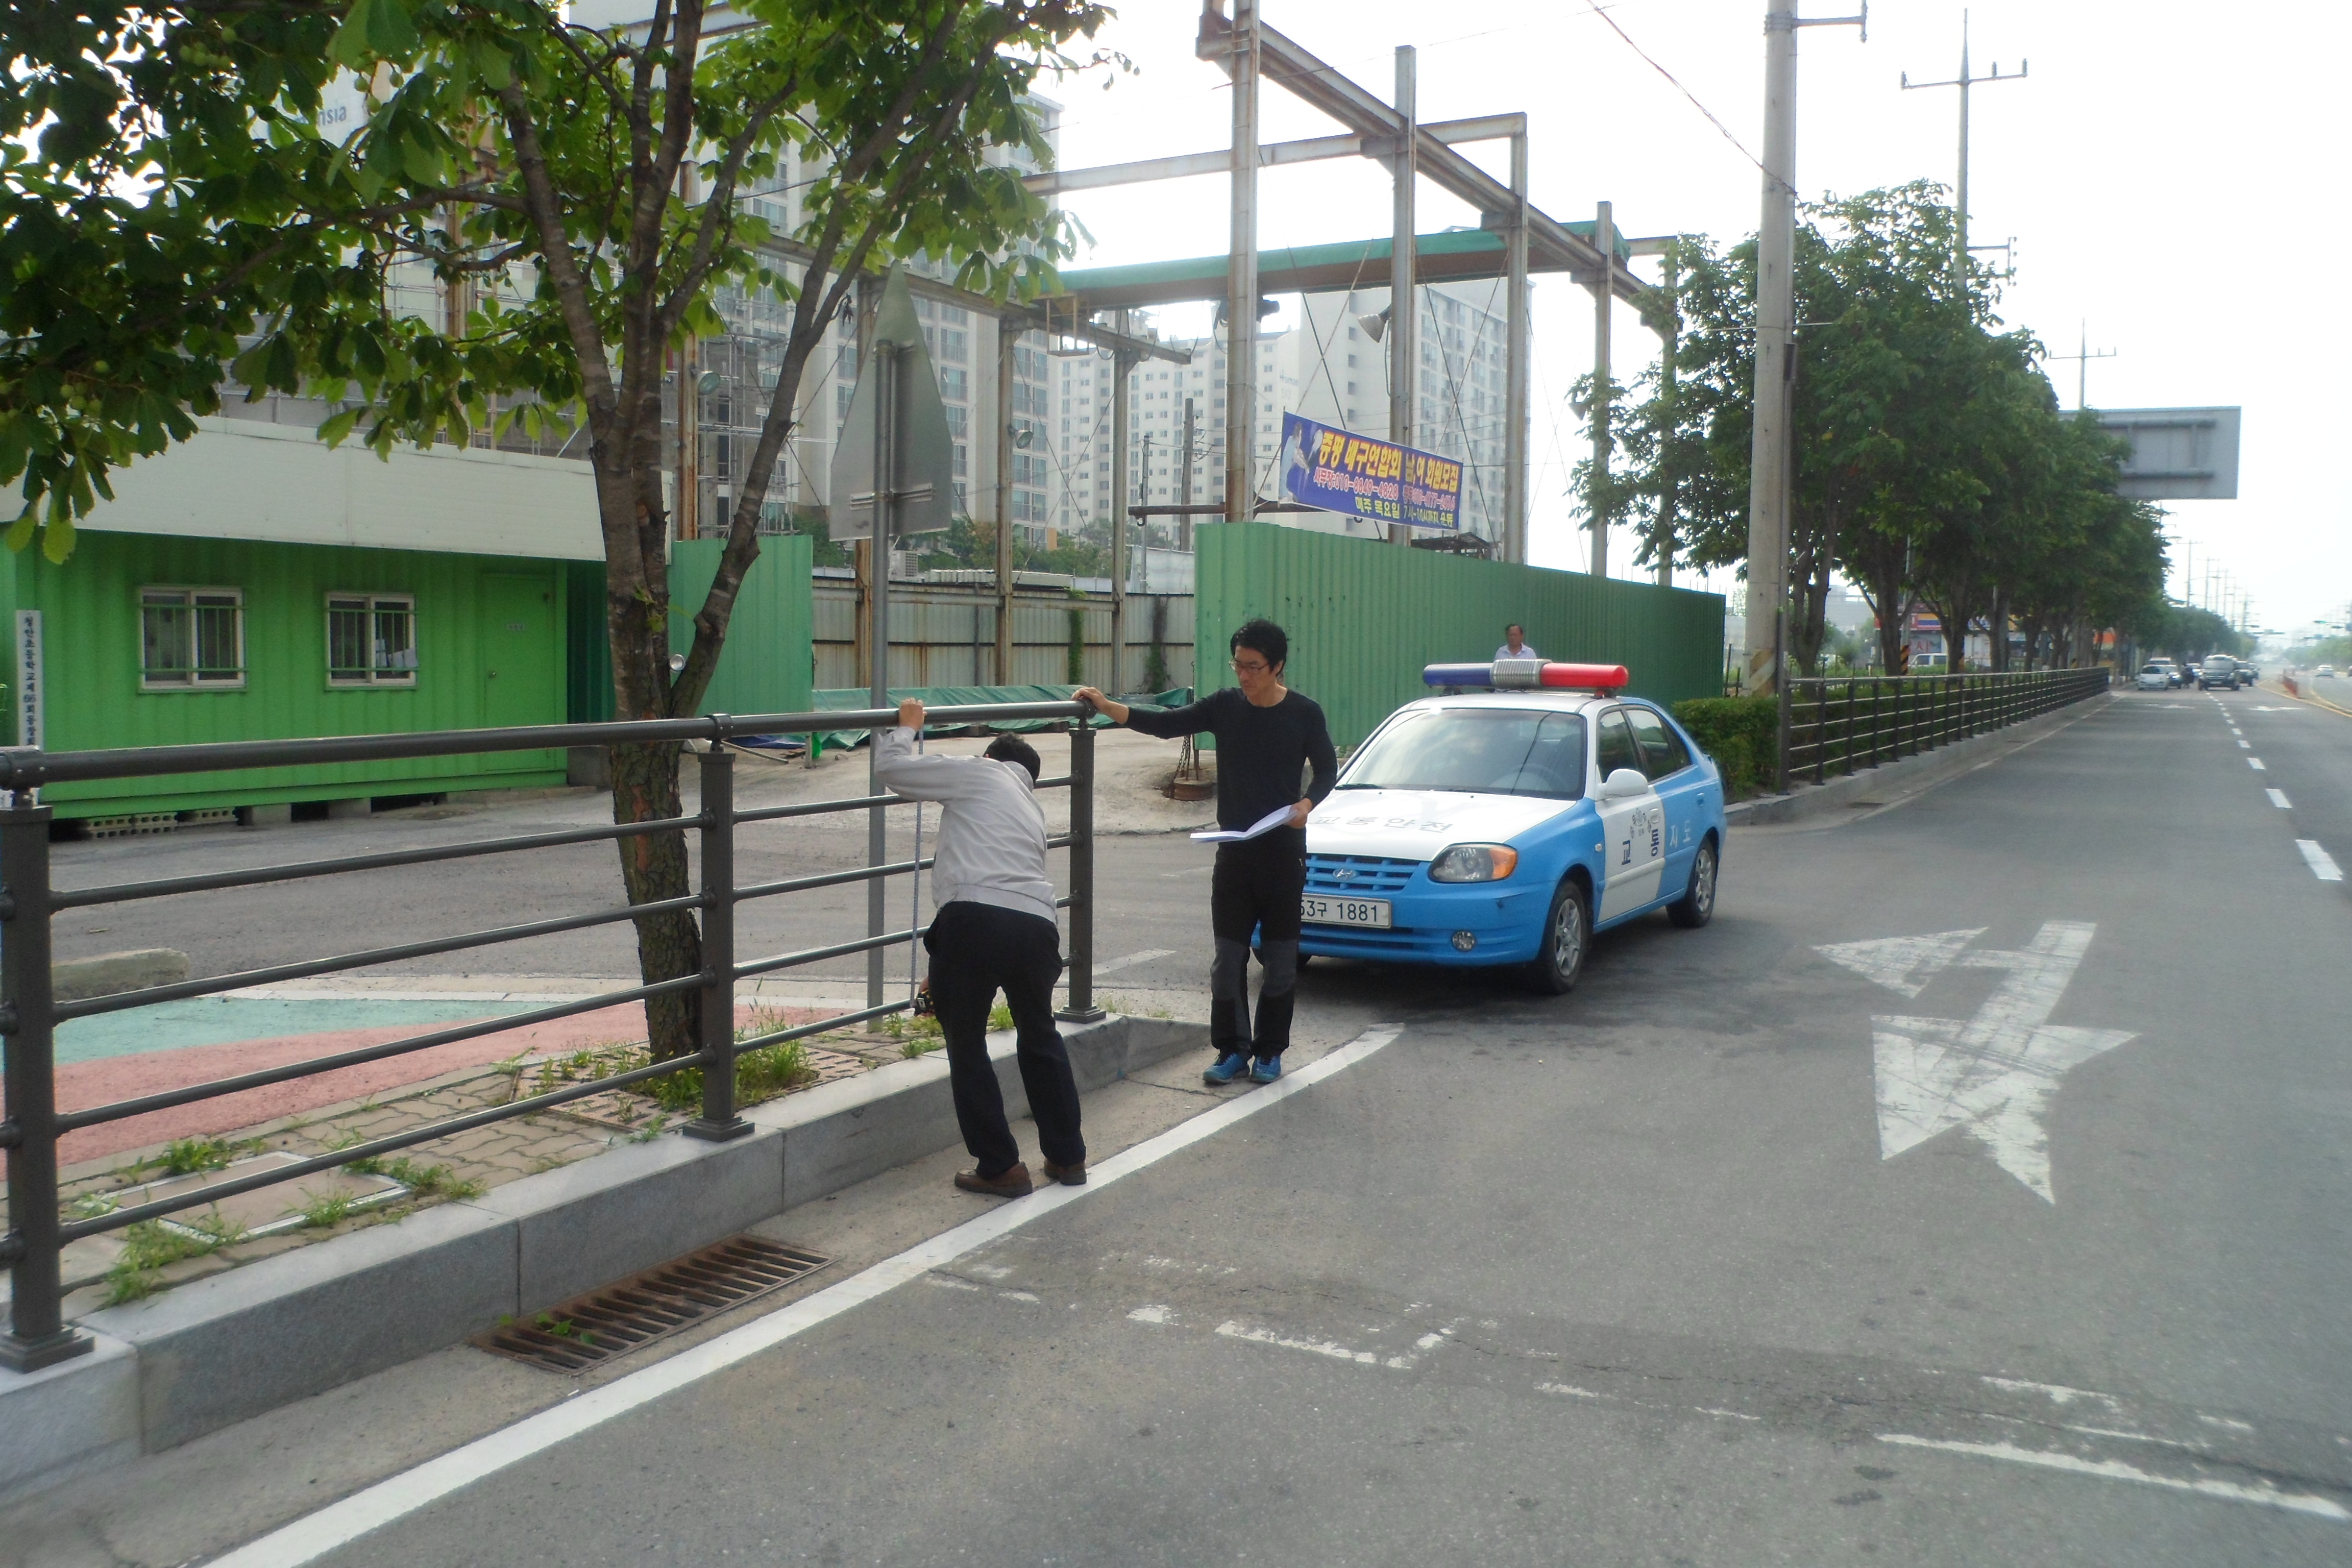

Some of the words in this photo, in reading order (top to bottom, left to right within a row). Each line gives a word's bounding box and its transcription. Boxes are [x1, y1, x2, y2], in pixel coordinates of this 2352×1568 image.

[1319, 431, 1345, 468] 증평
[1345, 439, 1401, 480] 배구연합회
[1426, 459, 1459, 492] 회원모집
[1355, 496, 1372, 514] 매주
[1374, 500, 1400, 519] 목요일
[1308, 816, 1454, 834] 교통안전
[1670, 819, 1692, 848] 지도
[1337, 902, 1378, 922] 1881
